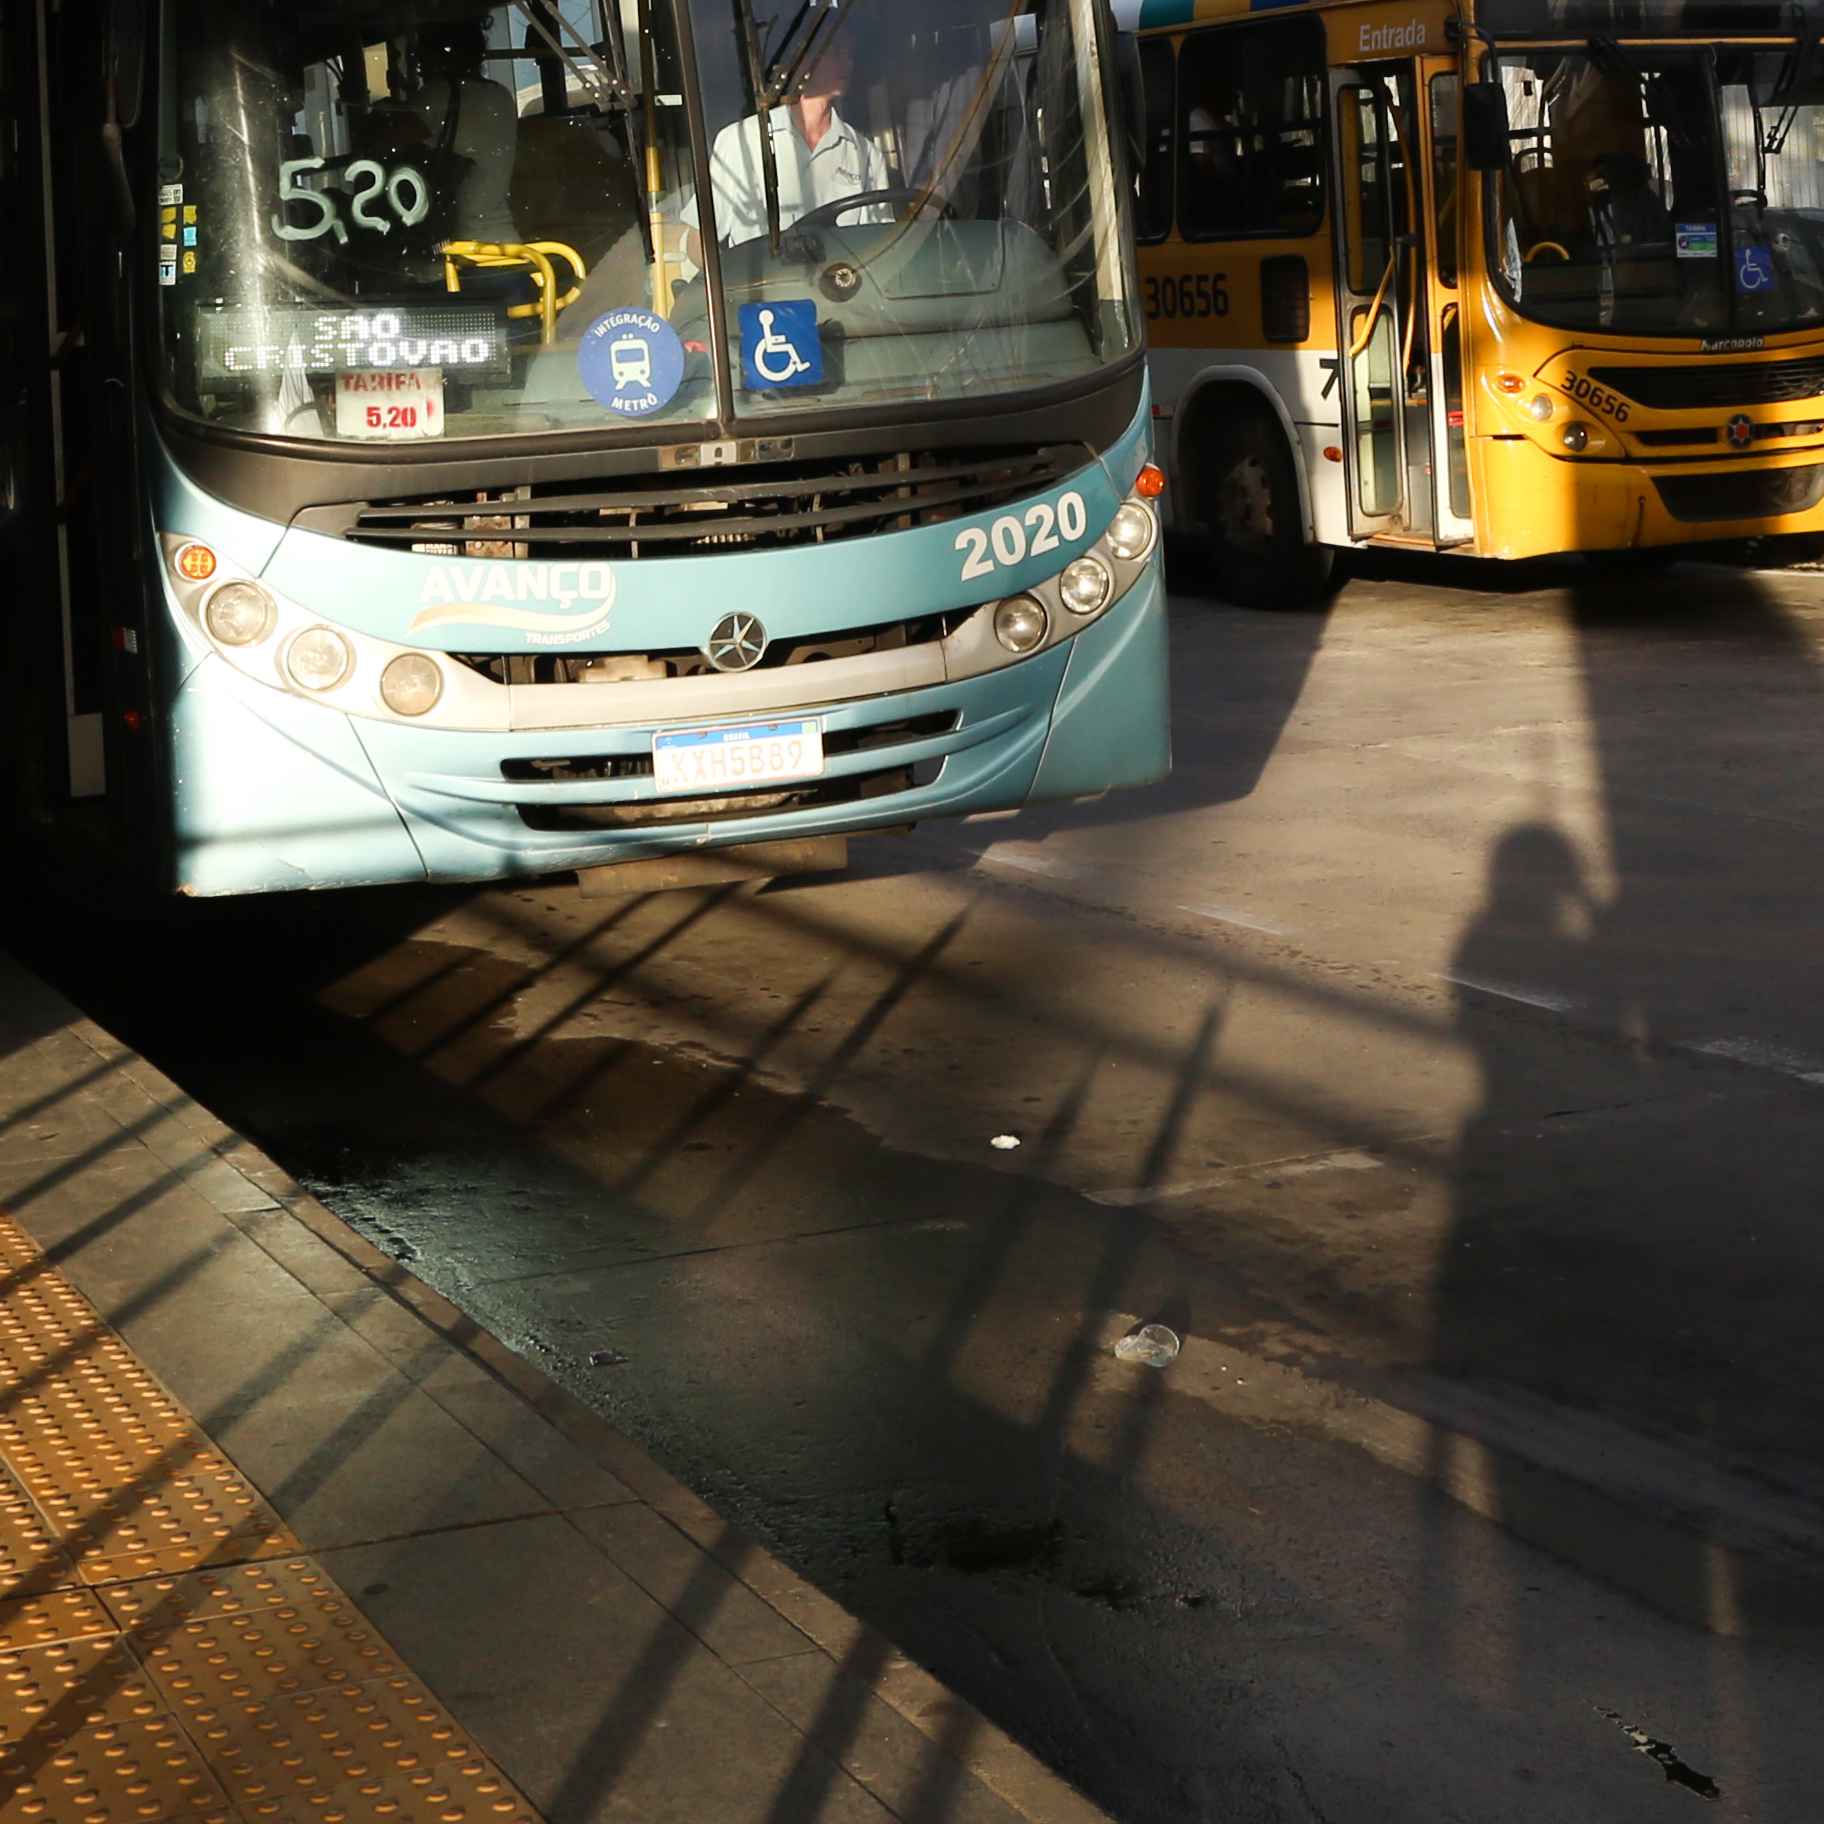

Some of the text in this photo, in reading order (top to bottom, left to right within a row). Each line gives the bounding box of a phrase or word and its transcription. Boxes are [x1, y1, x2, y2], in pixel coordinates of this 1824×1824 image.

[1359, 18, 1426, 51] Entrada
[271, 159, 429, 244] 5,20
[1145, 273, 1229, 320] 30656
[593, 313, 660, 338] INTEGRAÇÃO
[1701, 336, 1763, 351] Marcopolo
[341, 372, 422, 392] TARIFA
[1561, 370, 1631, 423] 30656
[611, 392, 658, 412] METRÔ
[366, 406, 417, 429] 5,20
[954, 491, 1087, 582] 2020
[418, 562, 612, 609] AVANÇO
[525, 619, 612, 645] TRANSPORTES
[722, 731, 751, 742] BRASIL
[670, 739, 803, 784] KXH5B89
